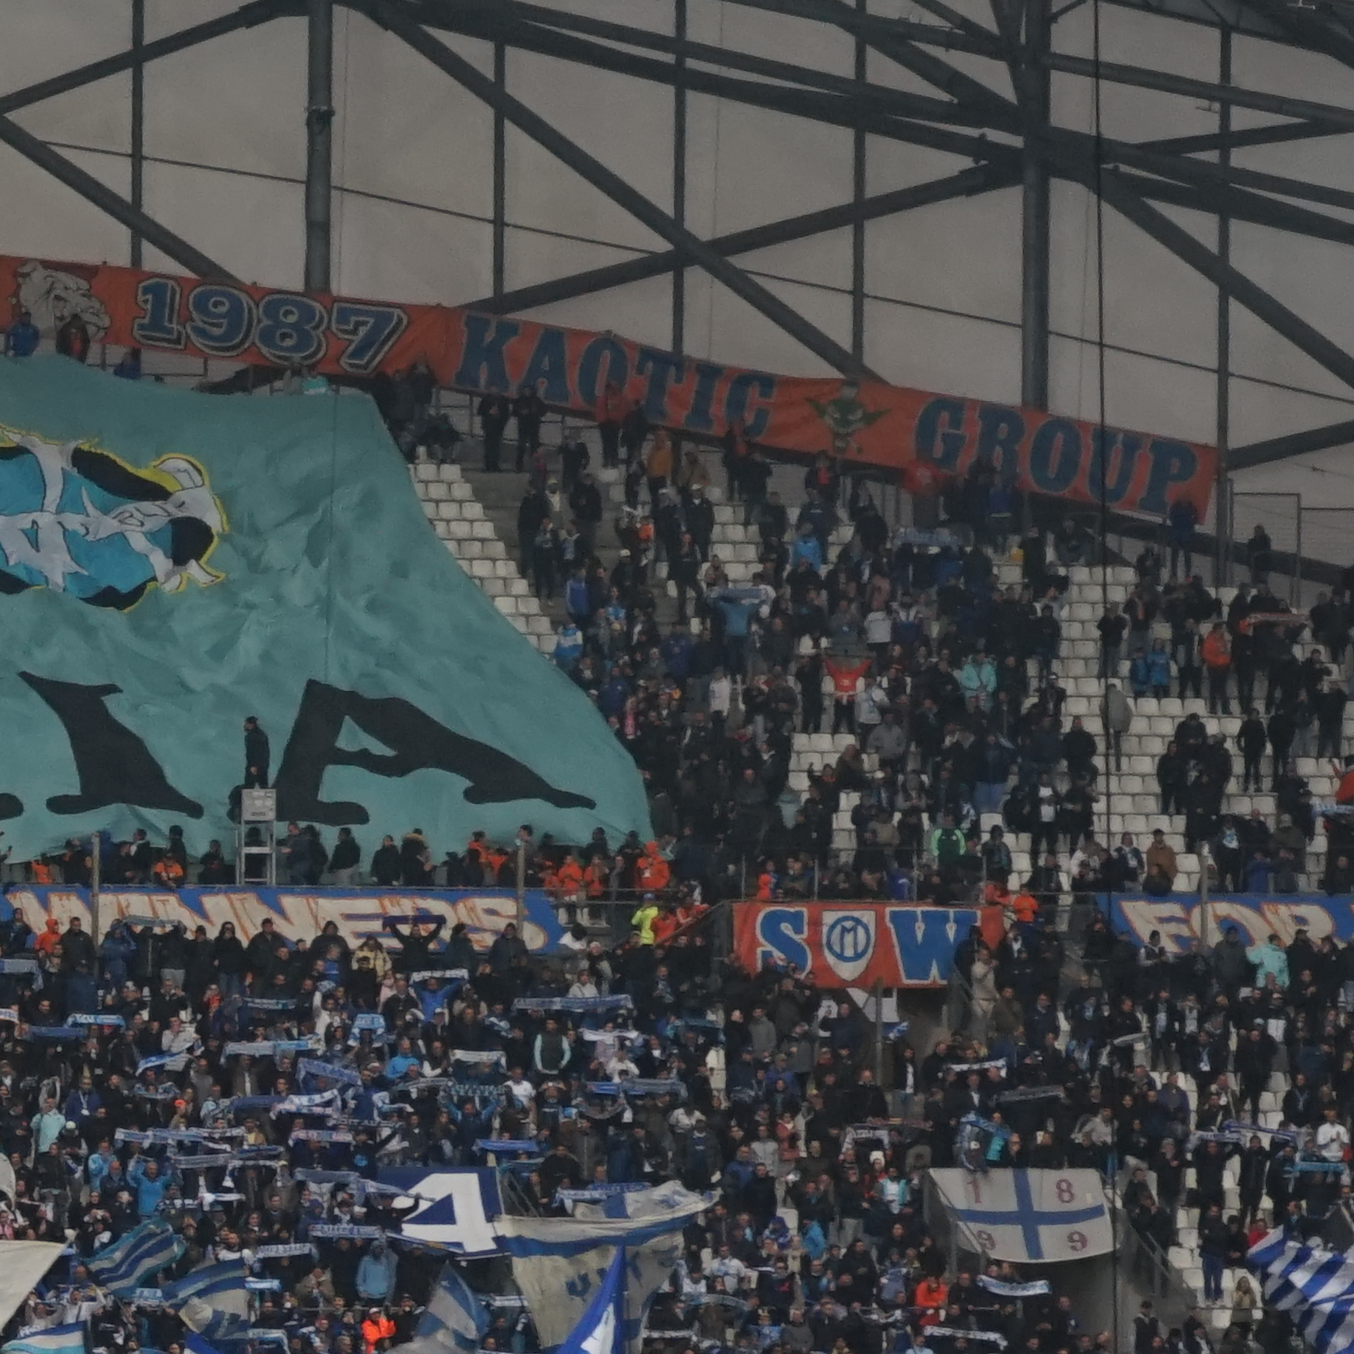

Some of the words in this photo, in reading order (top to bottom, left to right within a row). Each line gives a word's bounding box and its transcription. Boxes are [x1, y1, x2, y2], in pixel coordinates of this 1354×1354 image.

[131, 277, 410, 376] 1987
[454, 313, 778, 441] KAOTIC
[912, 395, 1202, 518] GROUP
[7, 889, 549, 953] WINNERS
